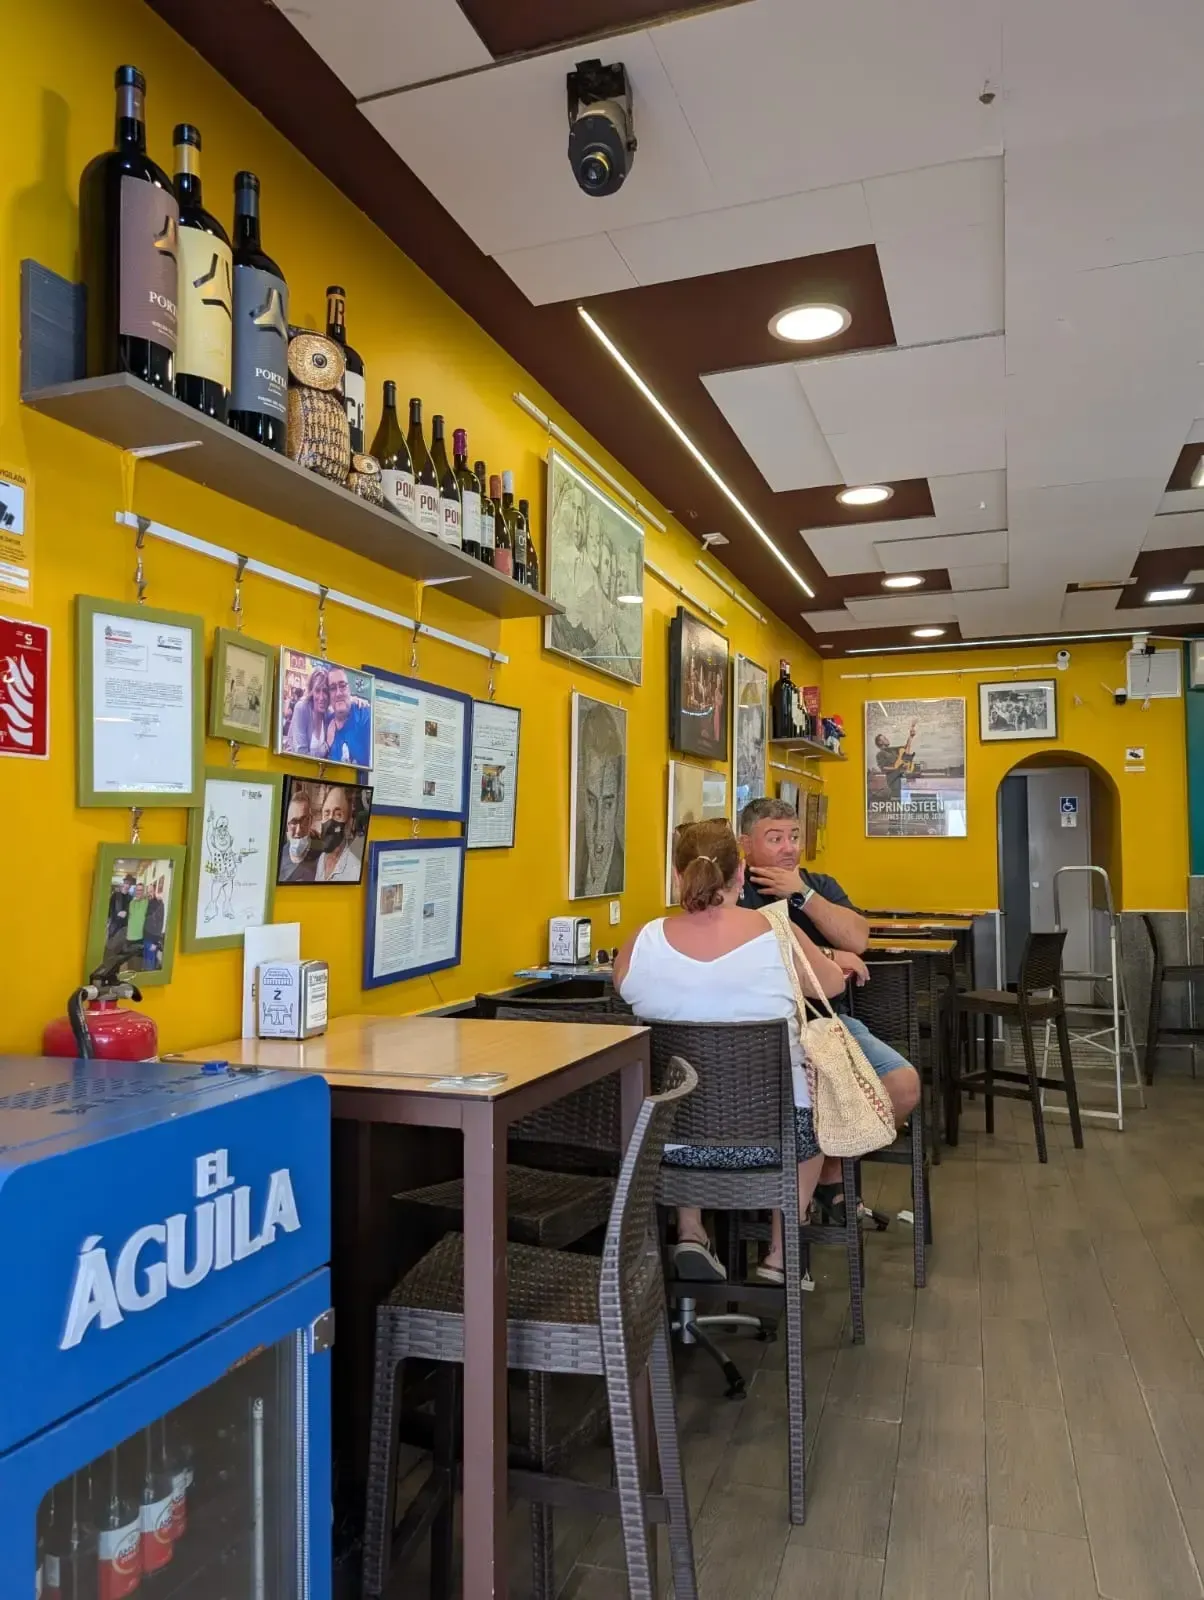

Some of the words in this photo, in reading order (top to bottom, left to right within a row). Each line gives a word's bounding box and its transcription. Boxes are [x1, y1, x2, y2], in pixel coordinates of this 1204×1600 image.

[872, 801, 944, 813] SPRINGSTEEN
[196, 1149, 236, 1198] EL
[60, 1168, 302, 1351] ÁGUILA
